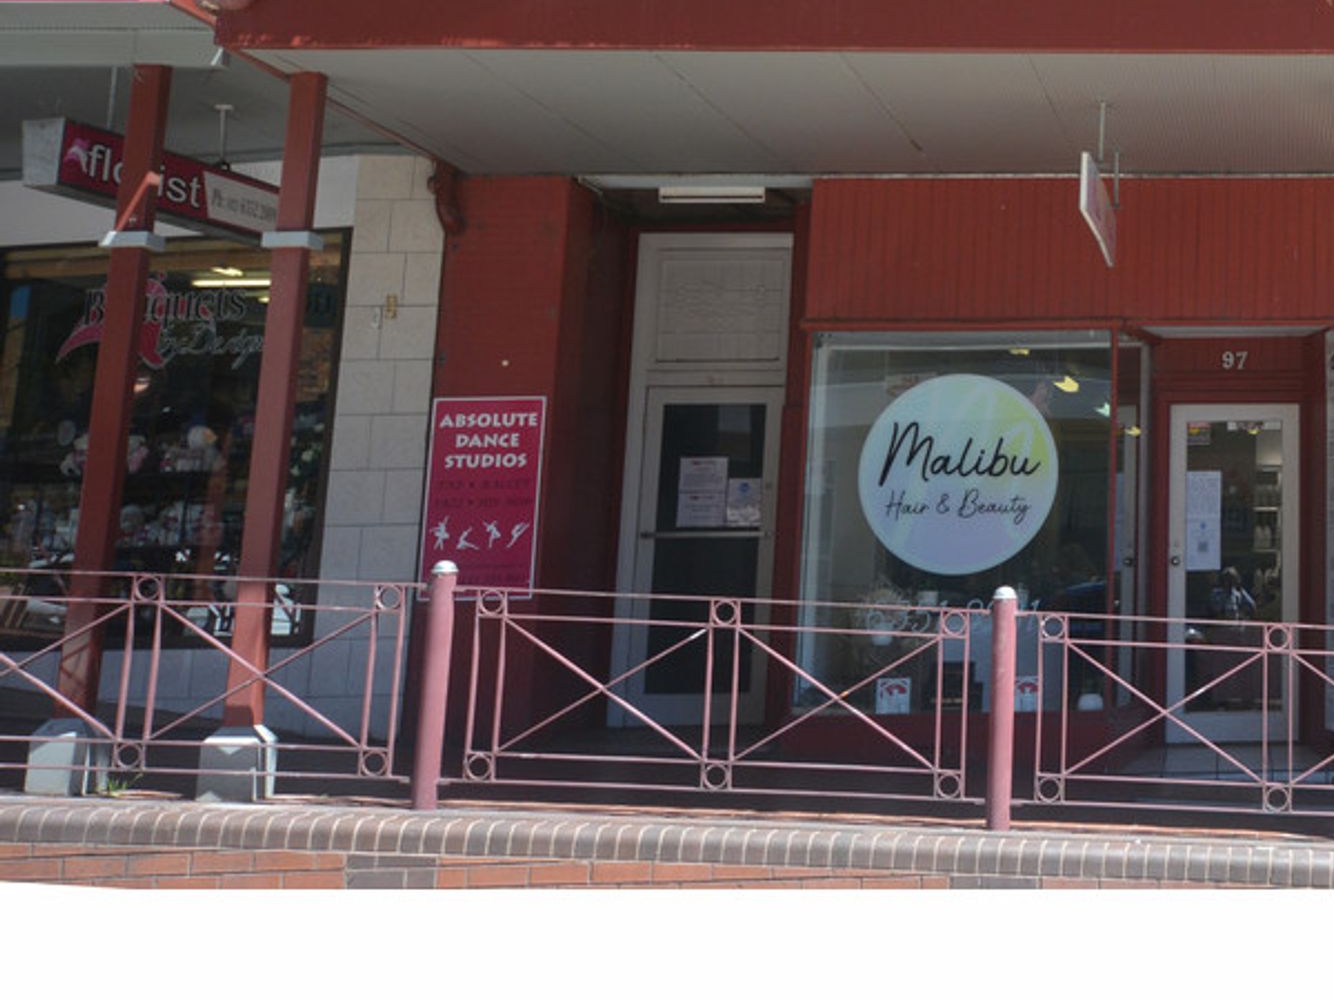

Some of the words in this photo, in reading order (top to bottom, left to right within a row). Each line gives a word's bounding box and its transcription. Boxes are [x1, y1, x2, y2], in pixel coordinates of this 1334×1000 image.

[88, 143, 201, 208] flist
[1221, 350, 1249, 370] 97
[438, 412, 539, 428] ABSOLUTE
[455, 432, 520, 448] DANCE
[443, 452, 528, 470] STUDIOS
[877, 421, 1042, 488] Malibu
[884, 490, 930, 522] Hair
[935, 493, 951, 515] &
[957, 488, 1033, 526] Beauty
